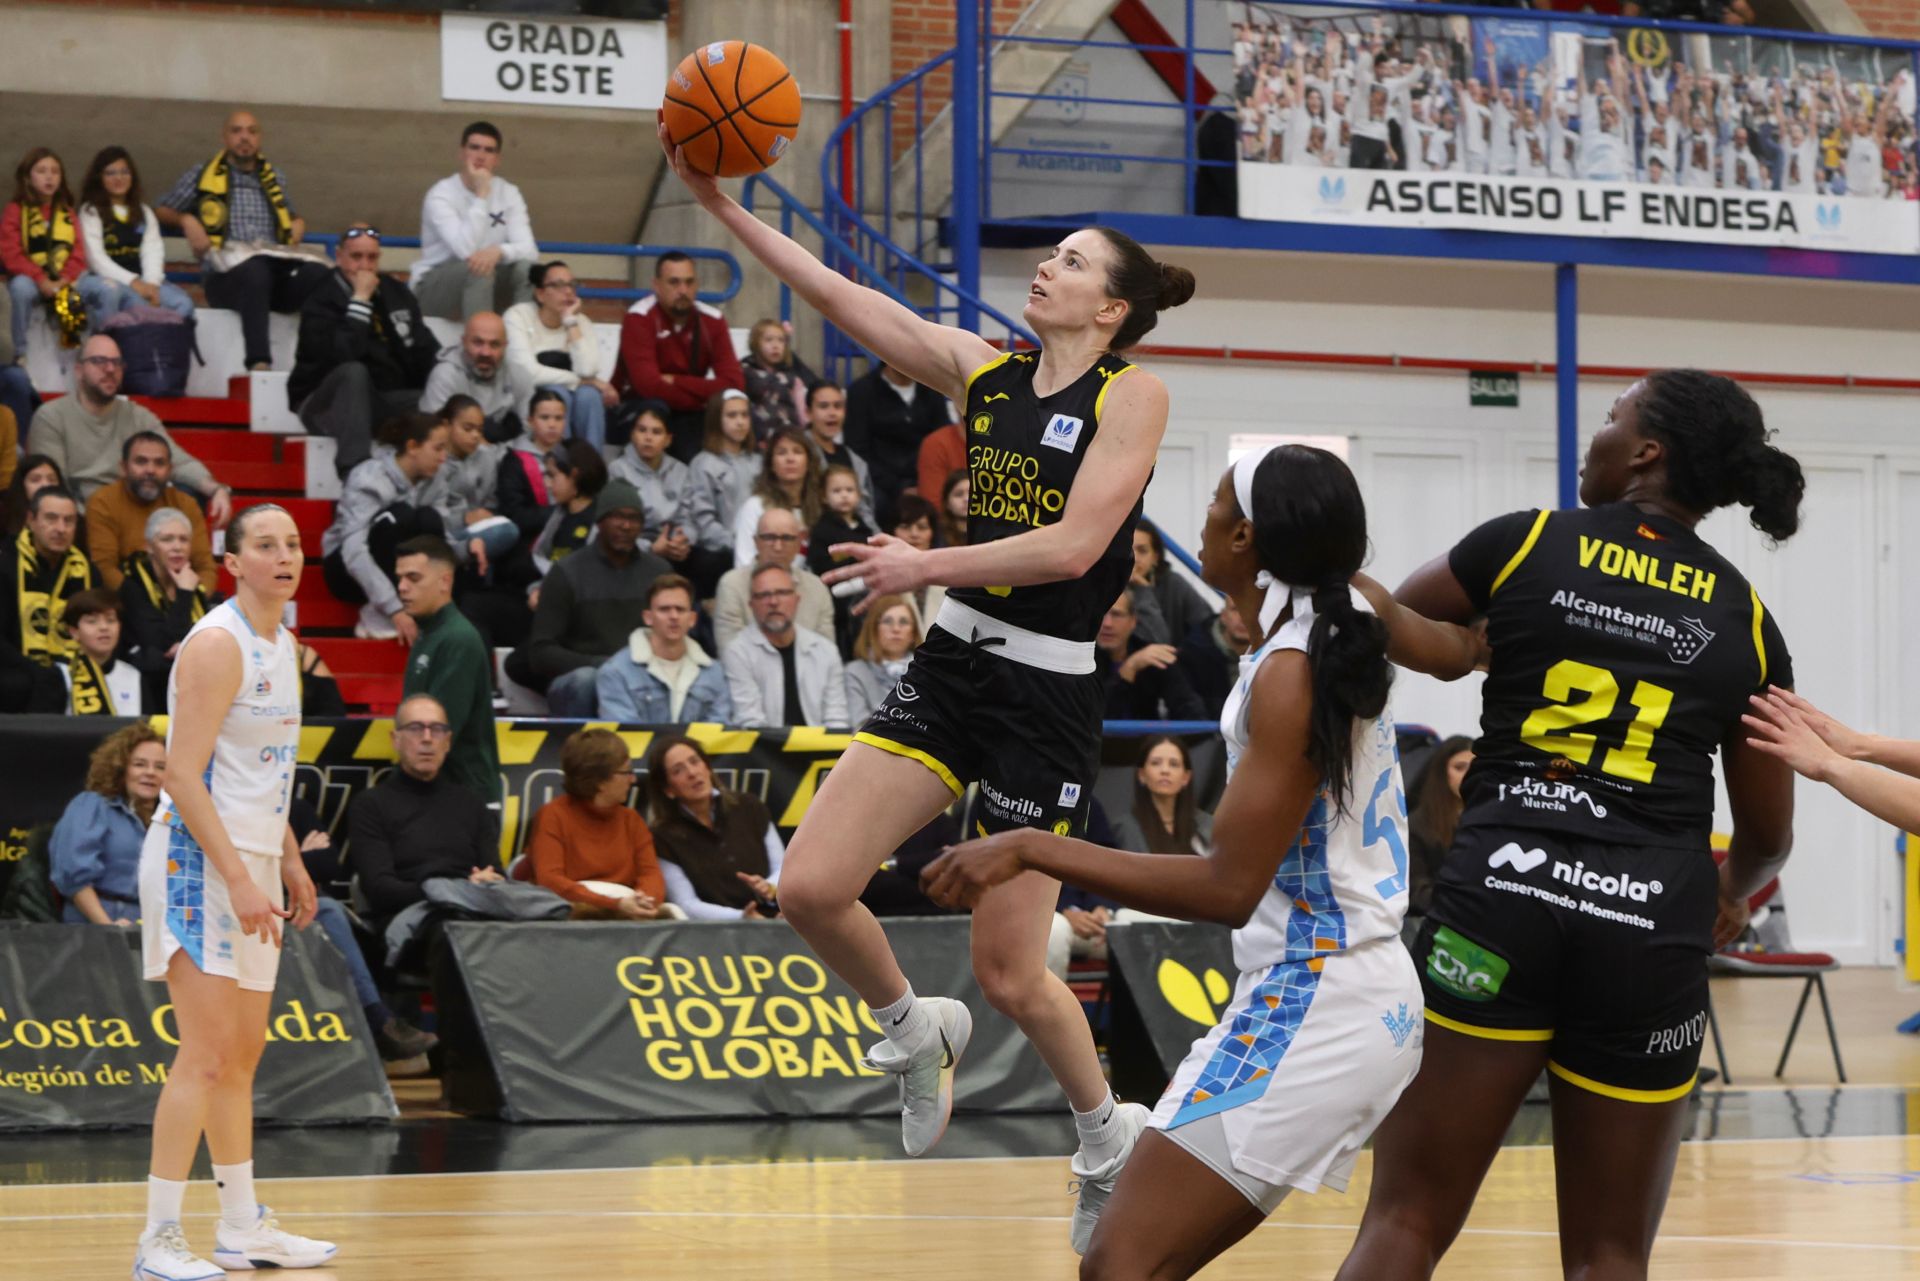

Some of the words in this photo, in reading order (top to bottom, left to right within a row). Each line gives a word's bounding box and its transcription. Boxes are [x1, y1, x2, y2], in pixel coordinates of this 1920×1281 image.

[486, 21, 624, 58] GRADA
[497, 61, 613, 95] OESTE
[1366, 178, 1563, 220] ASCENSO
[1579, 189, 1625, 222] LF
[1641, 194, 1798, 233] ENDESA
[1470, 377, 1518, 397] SALIDA
[969, 445, 1039, 481] GRUPO
[969, 494, 1046, 529] GLOBAL
[1578, 535, 1717, 604] VONLEH
[1550, 589, 1677, 639] Alcantarilla
[1520, 659, 1674, 784] 21
[981, 778, 1043, 818] Alcantarilla
[1521, 796, 1568, 812] Murcia
[1484, 875, 1578, 910] Conservando
[1578, 900, 1656, 931] Momentos
[616, 954, 827, 997] GRUPO
[95, 1063, 132, 1085] de
[645, 1035, 886, 1080] GLOBAL
